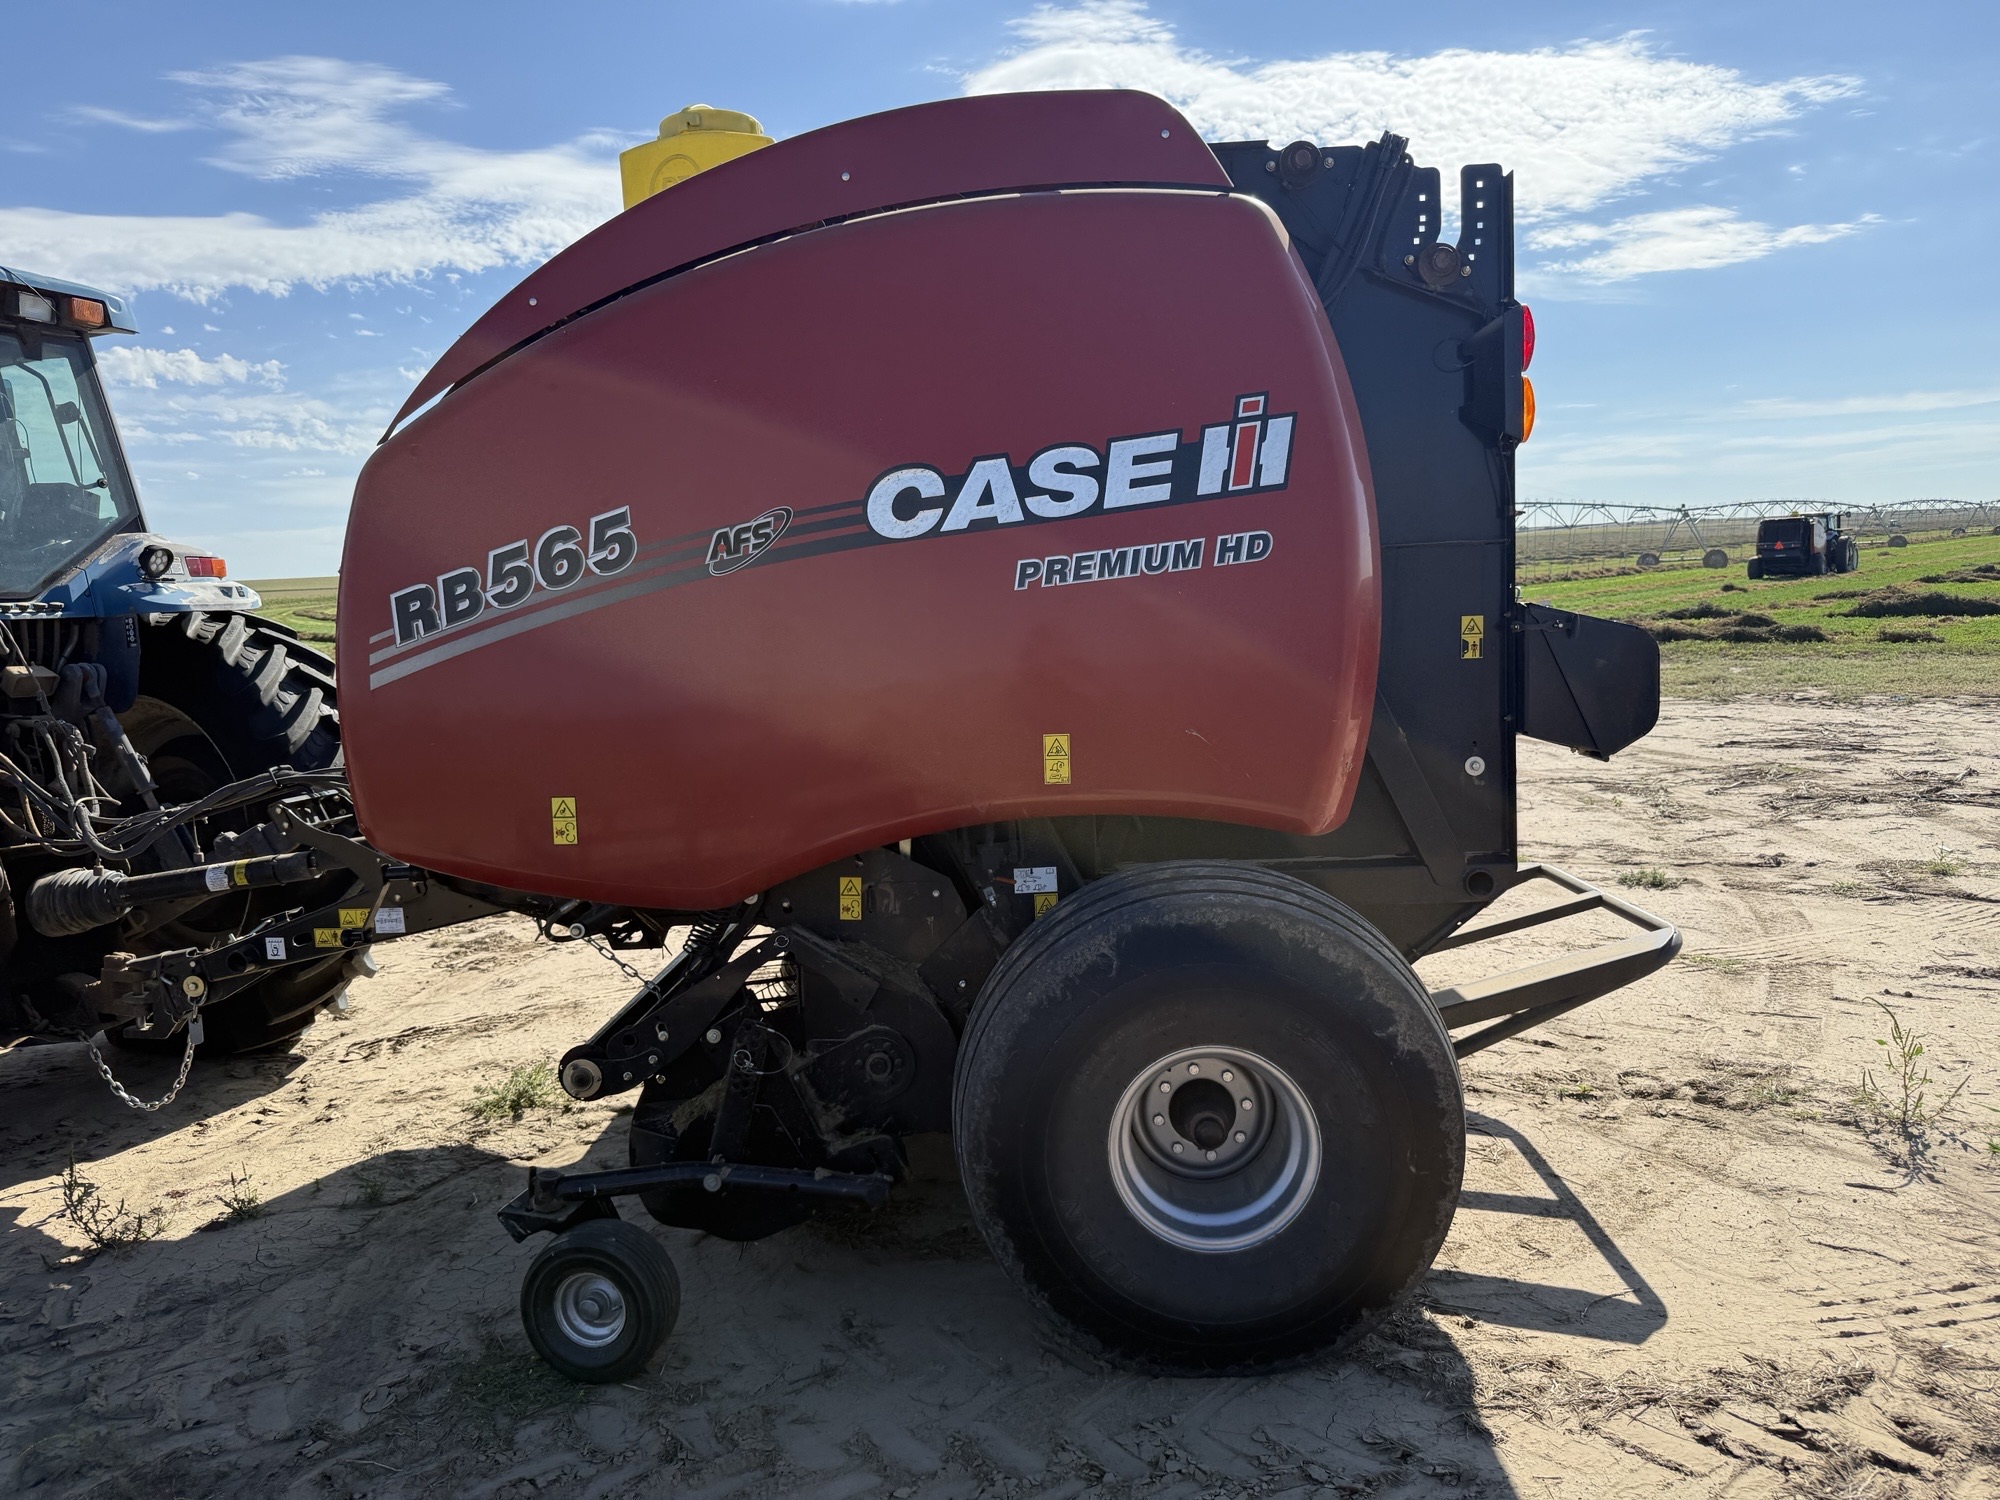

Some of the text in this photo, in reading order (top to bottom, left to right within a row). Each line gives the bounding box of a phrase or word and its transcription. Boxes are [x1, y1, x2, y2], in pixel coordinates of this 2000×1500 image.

[866, 432, 1180, 540] CASE
[389, 504, 638, 648] RB565
[705, 516, 775, 565] AFS
[1013, 529, 1274, 591] PREMIUM HD
[1057, 1200, 1145, 1294] TITAN
